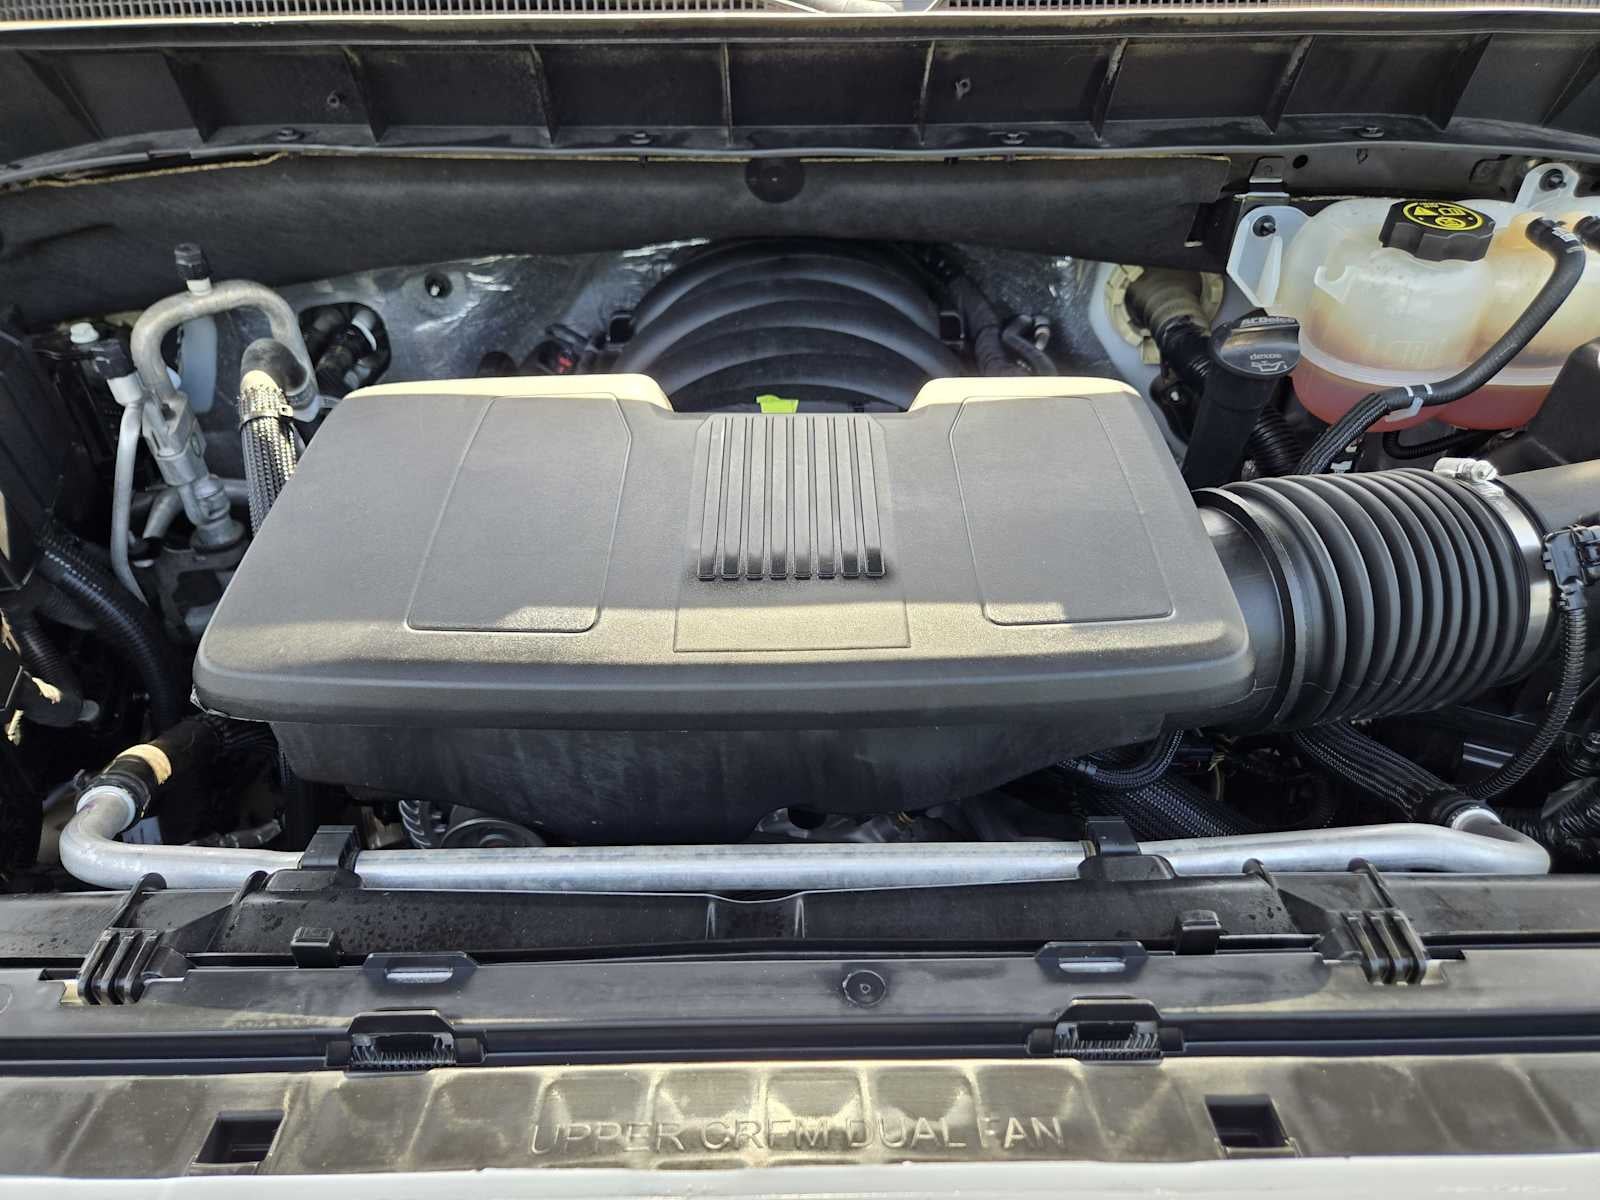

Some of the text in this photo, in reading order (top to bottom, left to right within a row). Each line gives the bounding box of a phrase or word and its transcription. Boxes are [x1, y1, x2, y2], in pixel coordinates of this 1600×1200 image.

[530, 1122, 686, 1156] UPPER
[849, 1116, 968, 1150] DUAL
[977, 1116, 1065, 1150] FAN
